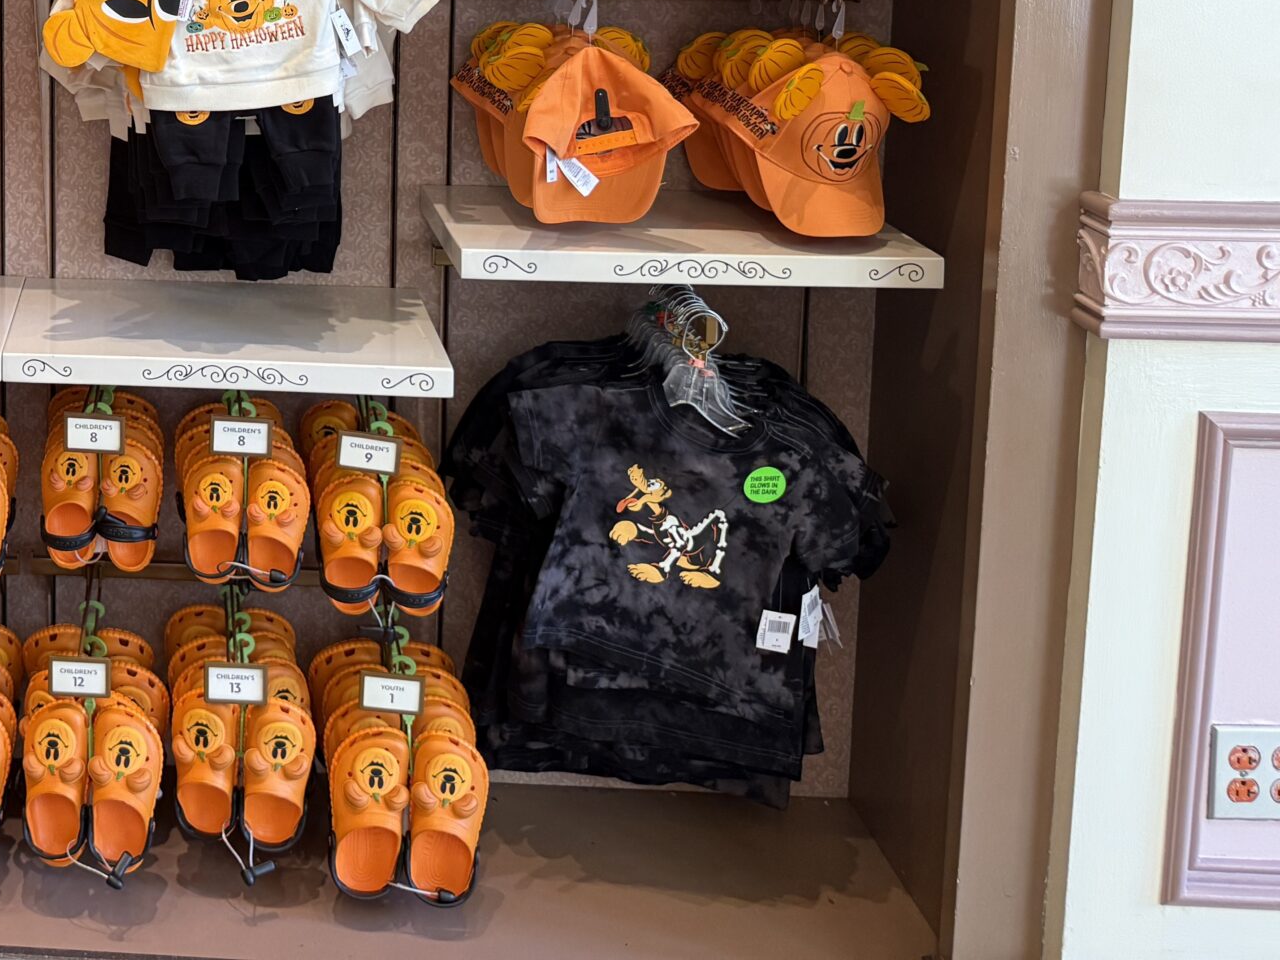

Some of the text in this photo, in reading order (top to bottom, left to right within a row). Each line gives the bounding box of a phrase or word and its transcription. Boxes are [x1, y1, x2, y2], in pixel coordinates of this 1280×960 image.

[229, 15, 306, 50] HALLOWEEN
[184, 31, 228, 53] HAPPY
[222, 426, 261, 434] CHILDREN'S
[90, 432, 98, 443] 8
[237, 435, 246, 446] 8
[350, 442, 390, 453] CHILDREN'S
[364, 452, 373, 463] 9
[59, 667, 98, 675] CHILDREN'S
[72, 676, 85, 687] 12
[216, 673, 255, 681] CHILDREN'S
[229, 682, 241, 693] 13
[381, 684, 405, 692] YOUTH
[389, 693, 394, 703] 1
